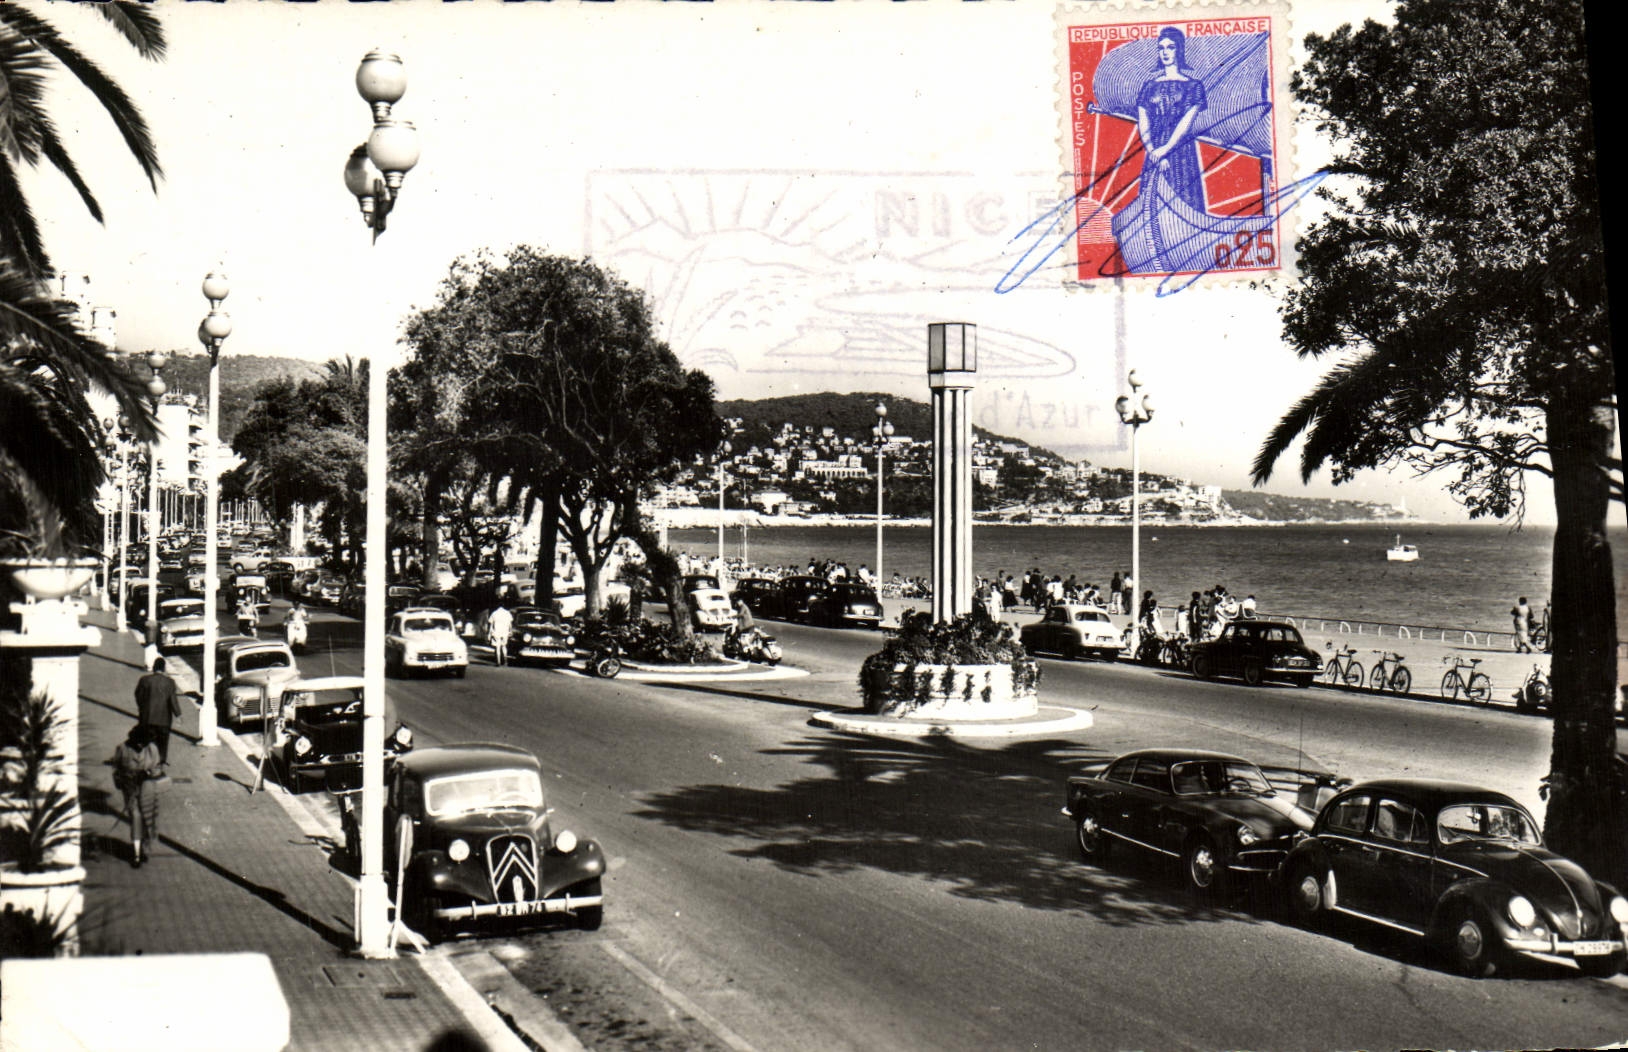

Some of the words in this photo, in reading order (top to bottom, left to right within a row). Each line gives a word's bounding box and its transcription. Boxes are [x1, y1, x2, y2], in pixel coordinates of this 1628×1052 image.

[1074, 26, 1158, 41] REPUBLIQUE
[1072, 72, 1086, 145] POSTES
[875, 190, 1066, 236] NICE
[980, 391, 1099, 430] d'Azur
